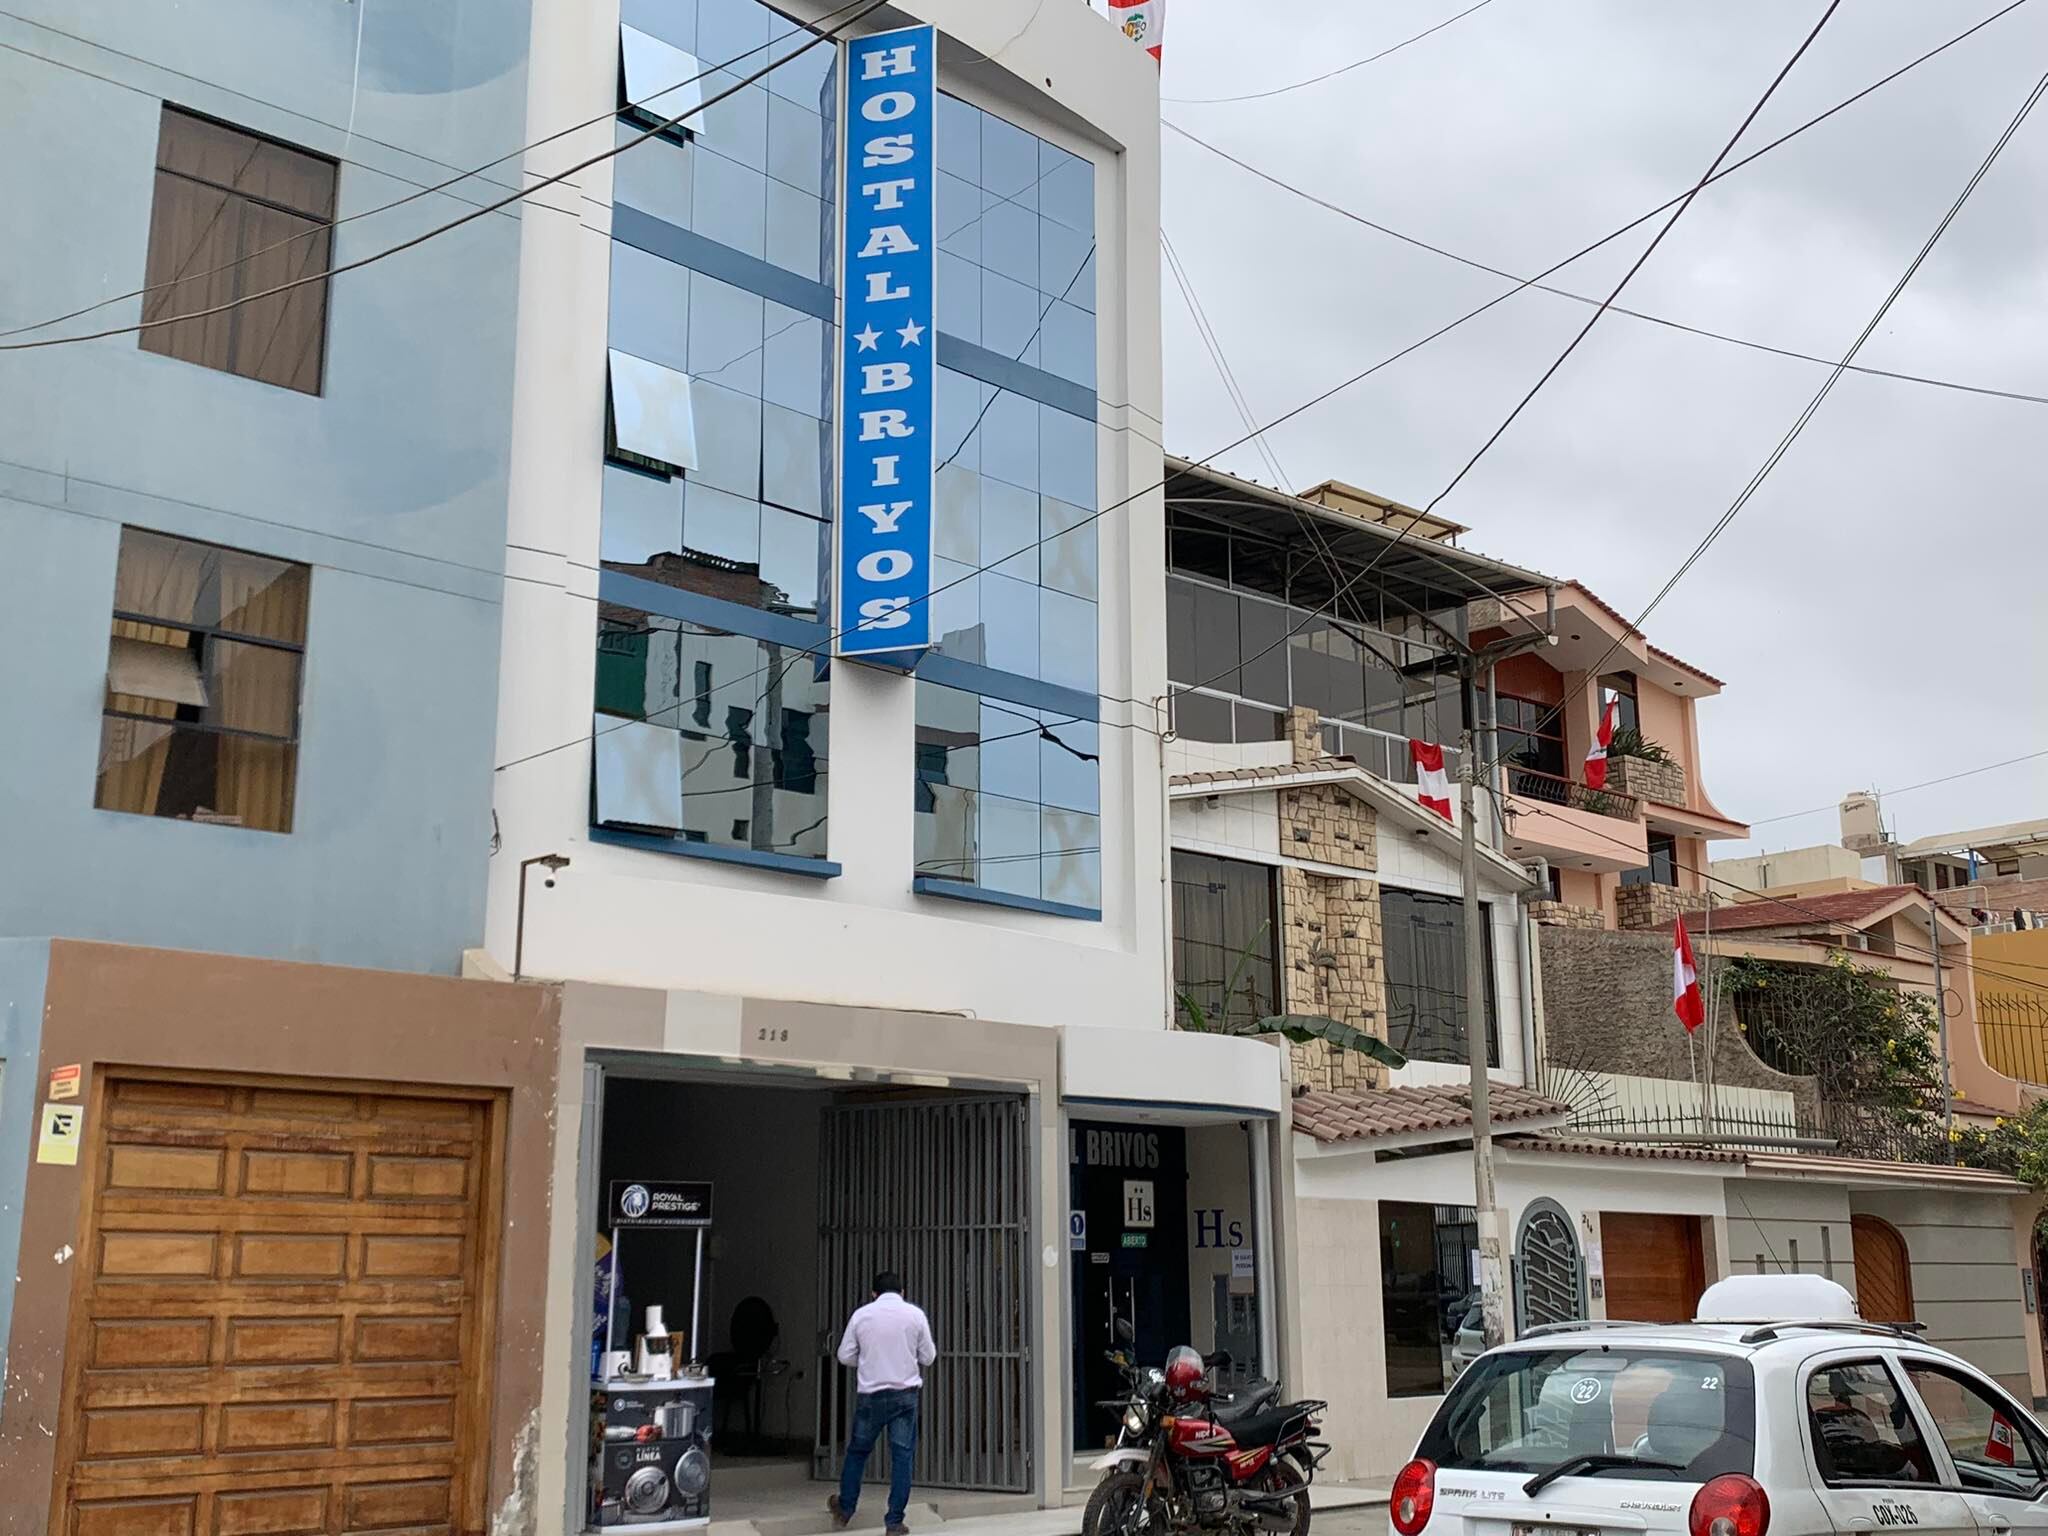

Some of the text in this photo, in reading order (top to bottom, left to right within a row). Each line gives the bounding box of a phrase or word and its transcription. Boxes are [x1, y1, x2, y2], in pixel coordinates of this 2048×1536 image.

[856, 44, 919, 632] HOSTAL BRIYOS
[1086, 1129, 1160, 1169] BRIYOS
[652, 1192, 684, 1202] ROYAL
[651, 1202, 698, 1211] PRESTIGE
[1701, 1376, 1718, 1390] 22
[1577, 1384, 1594, 1399] 22
[1440, 1487, 1505, 1501] SPARK LITE
